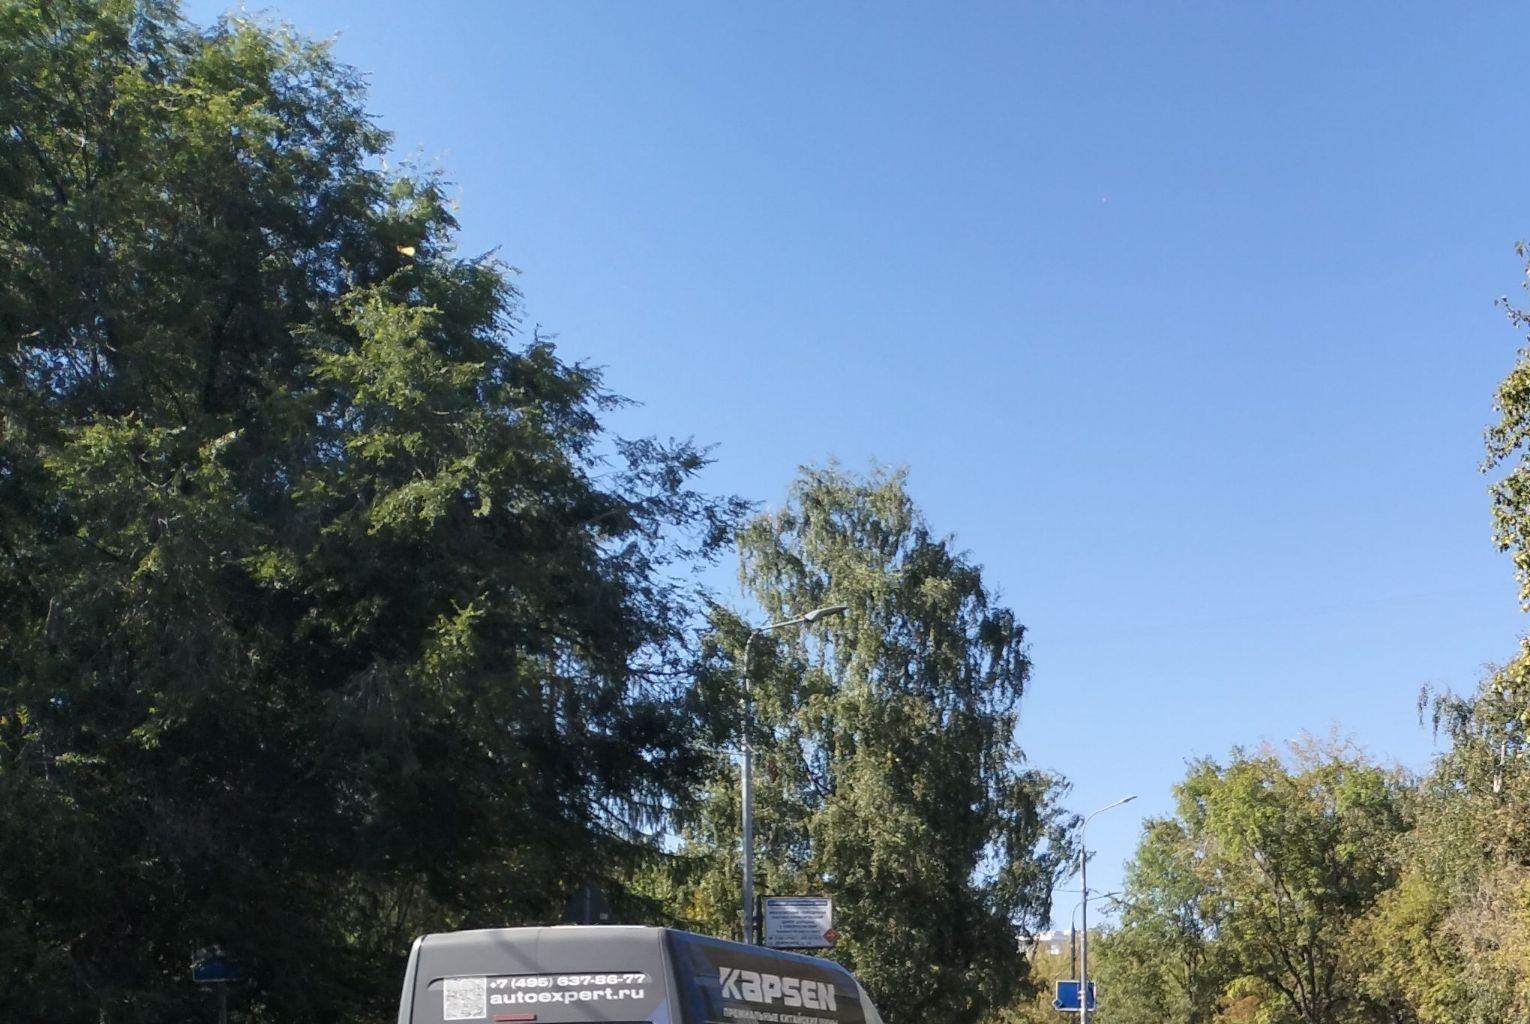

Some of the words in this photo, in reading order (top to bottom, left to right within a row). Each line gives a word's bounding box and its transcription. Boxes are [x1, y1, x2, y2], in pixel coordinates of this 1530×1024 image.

[511, 975, 551, 990] (495)
[556, 973, 647, 987] 637-86-77
[490, 987, 645, 1005] autoexpert.ru
